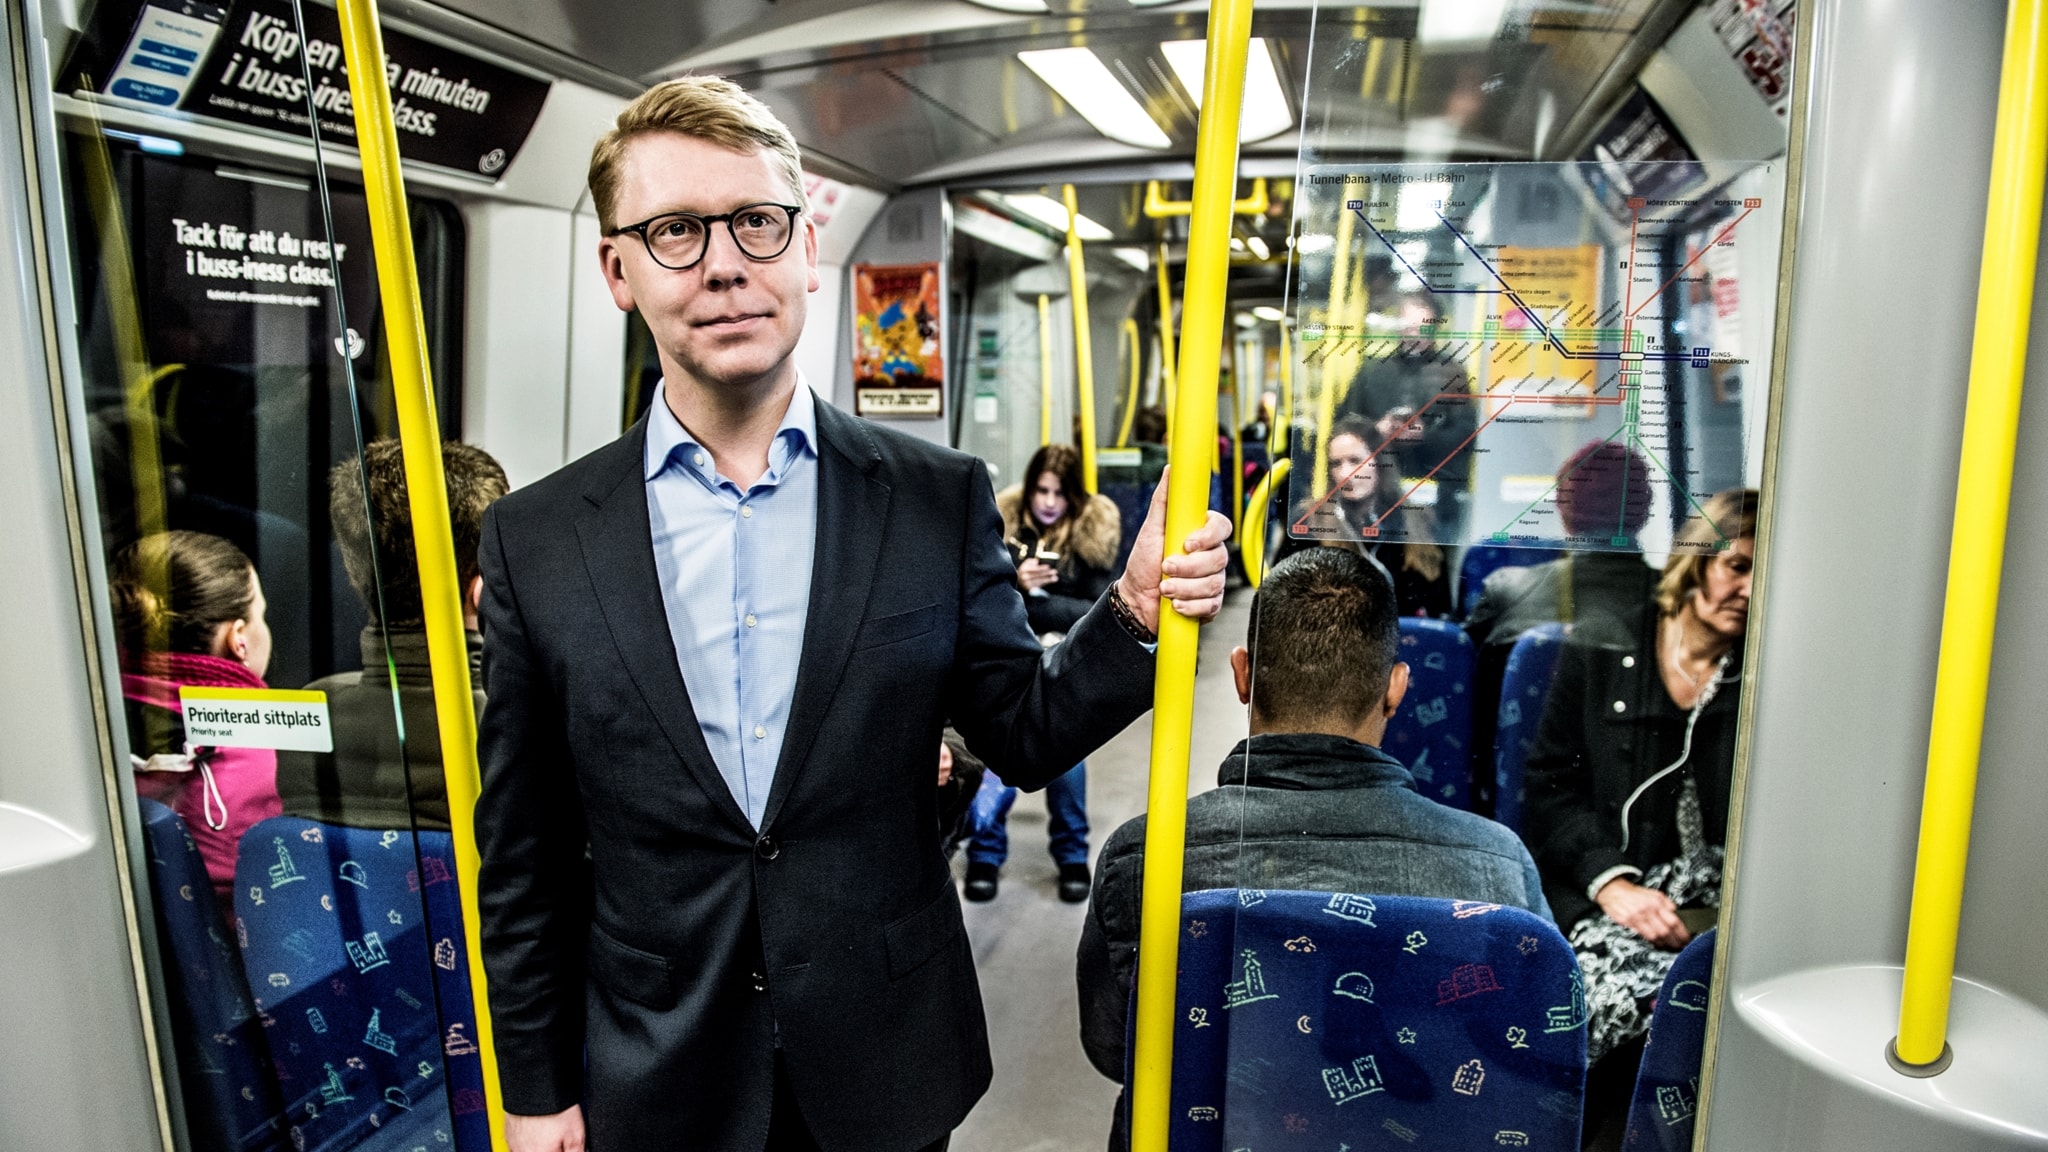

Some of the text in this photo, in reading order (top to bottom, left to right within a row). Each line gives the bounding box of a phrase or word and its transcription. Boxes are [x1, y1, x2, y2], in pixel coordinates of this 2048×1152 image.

[240, 11, 298, 63] Köp
[306, 39, 341, 70] en
[401, 67, 490, 114] minuten
[221, 52, 243, 85] i
[394, 98, 437, 137] lass.
[1309, 174, 1371, 185] Tunnelbana
[1381, 173, 1414, 184] Metro
[172, 218, 217, 248] Tack
[219, 224, 247, 251] för
[248, 229, 277, 255] att
[278, 231, 300, 257] du
[186, 249, 335, 287] i buss-iness class.
[188, 706, 321, 729] Prioriterad sittplats
[191, 727, 233, 738] Priority seat
